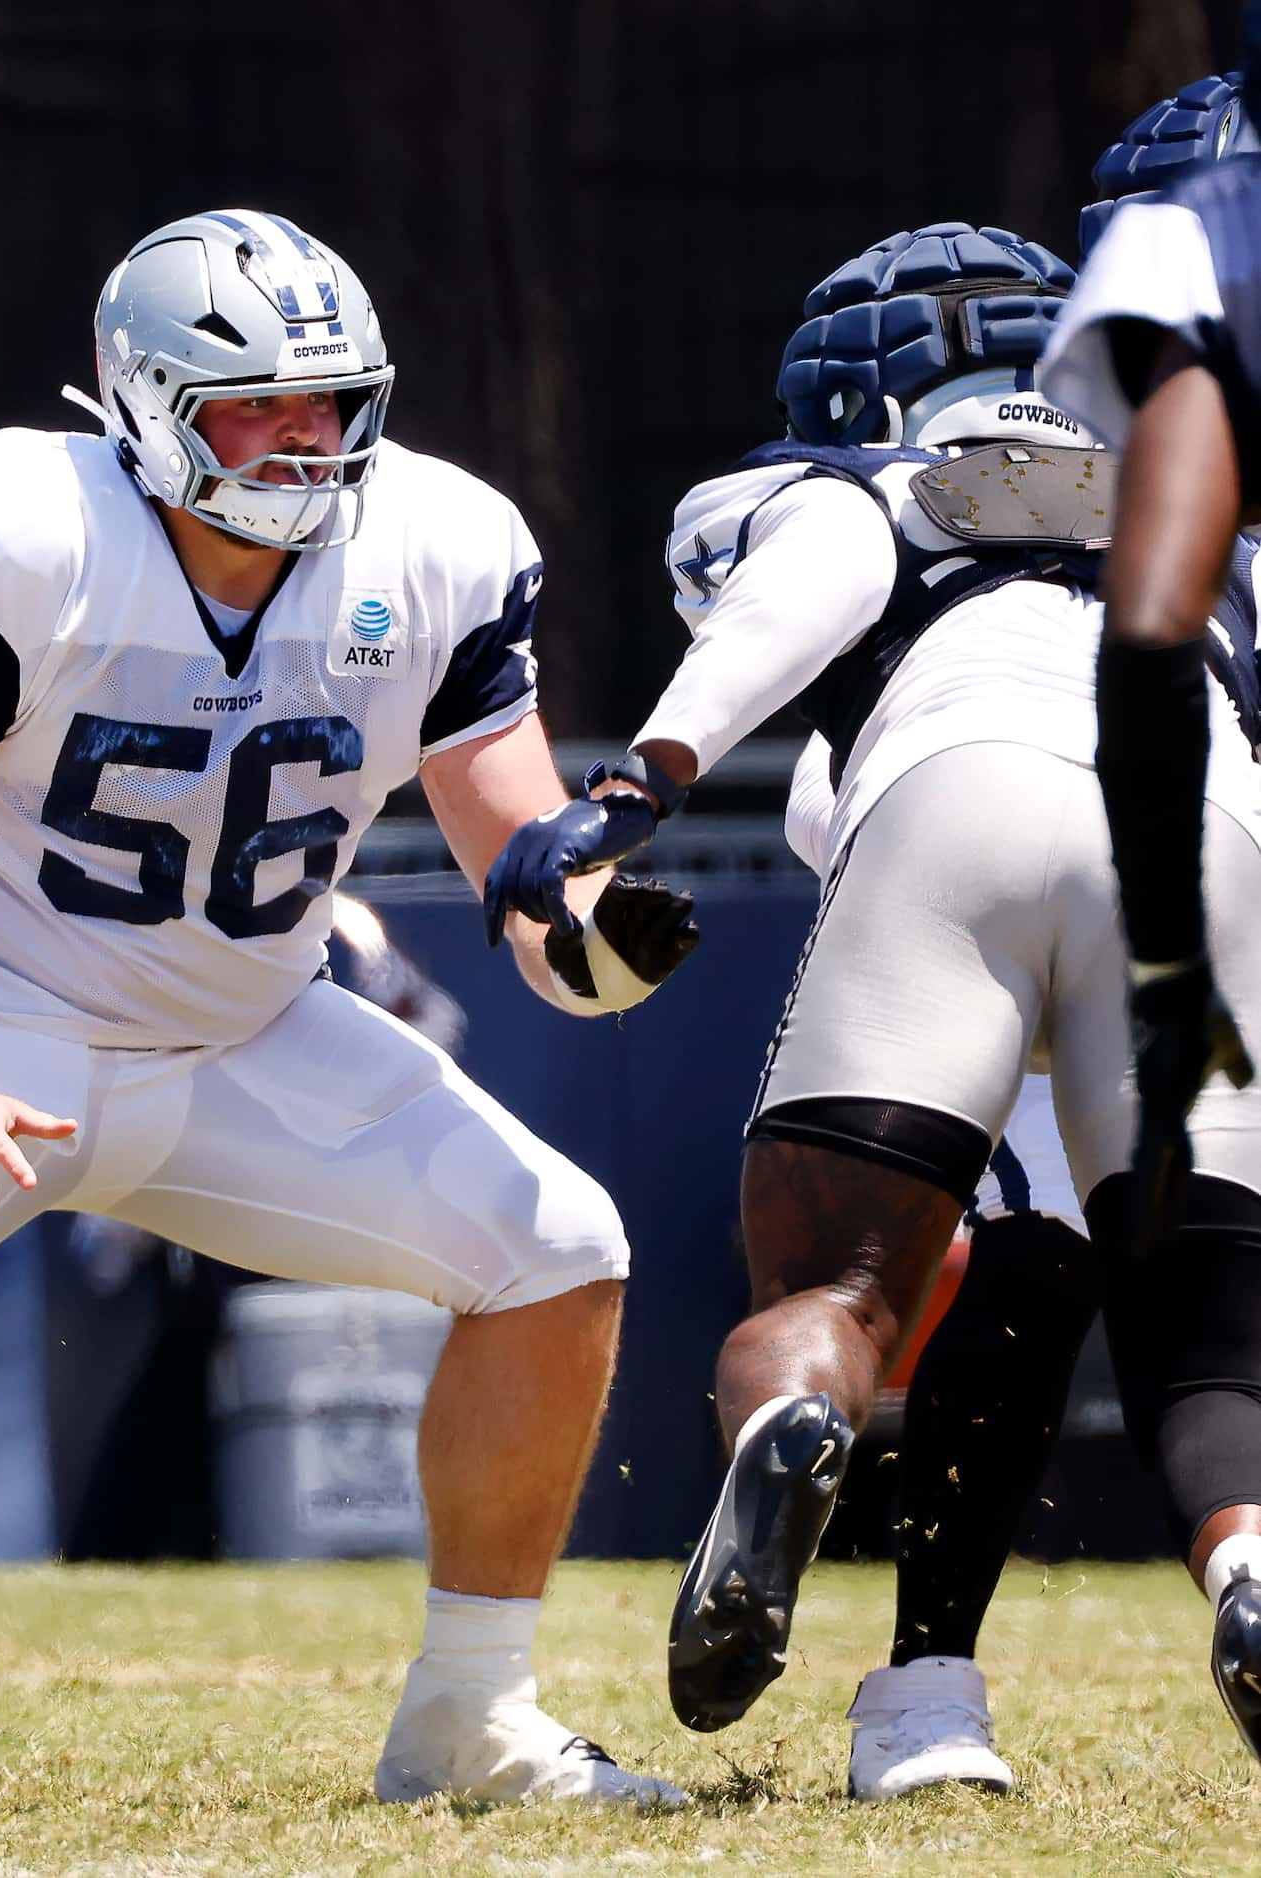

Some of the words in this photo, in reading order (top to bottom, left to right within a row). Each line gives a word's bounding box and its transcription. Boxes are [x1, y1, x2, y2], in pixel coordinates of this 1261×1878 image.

[294, 343, 348, 358] COWBOYS
[344, 647, 394, 668] AT&T
[193, 690, 263, 711] COWBOYS
[37, 713, 363, 940] 56
